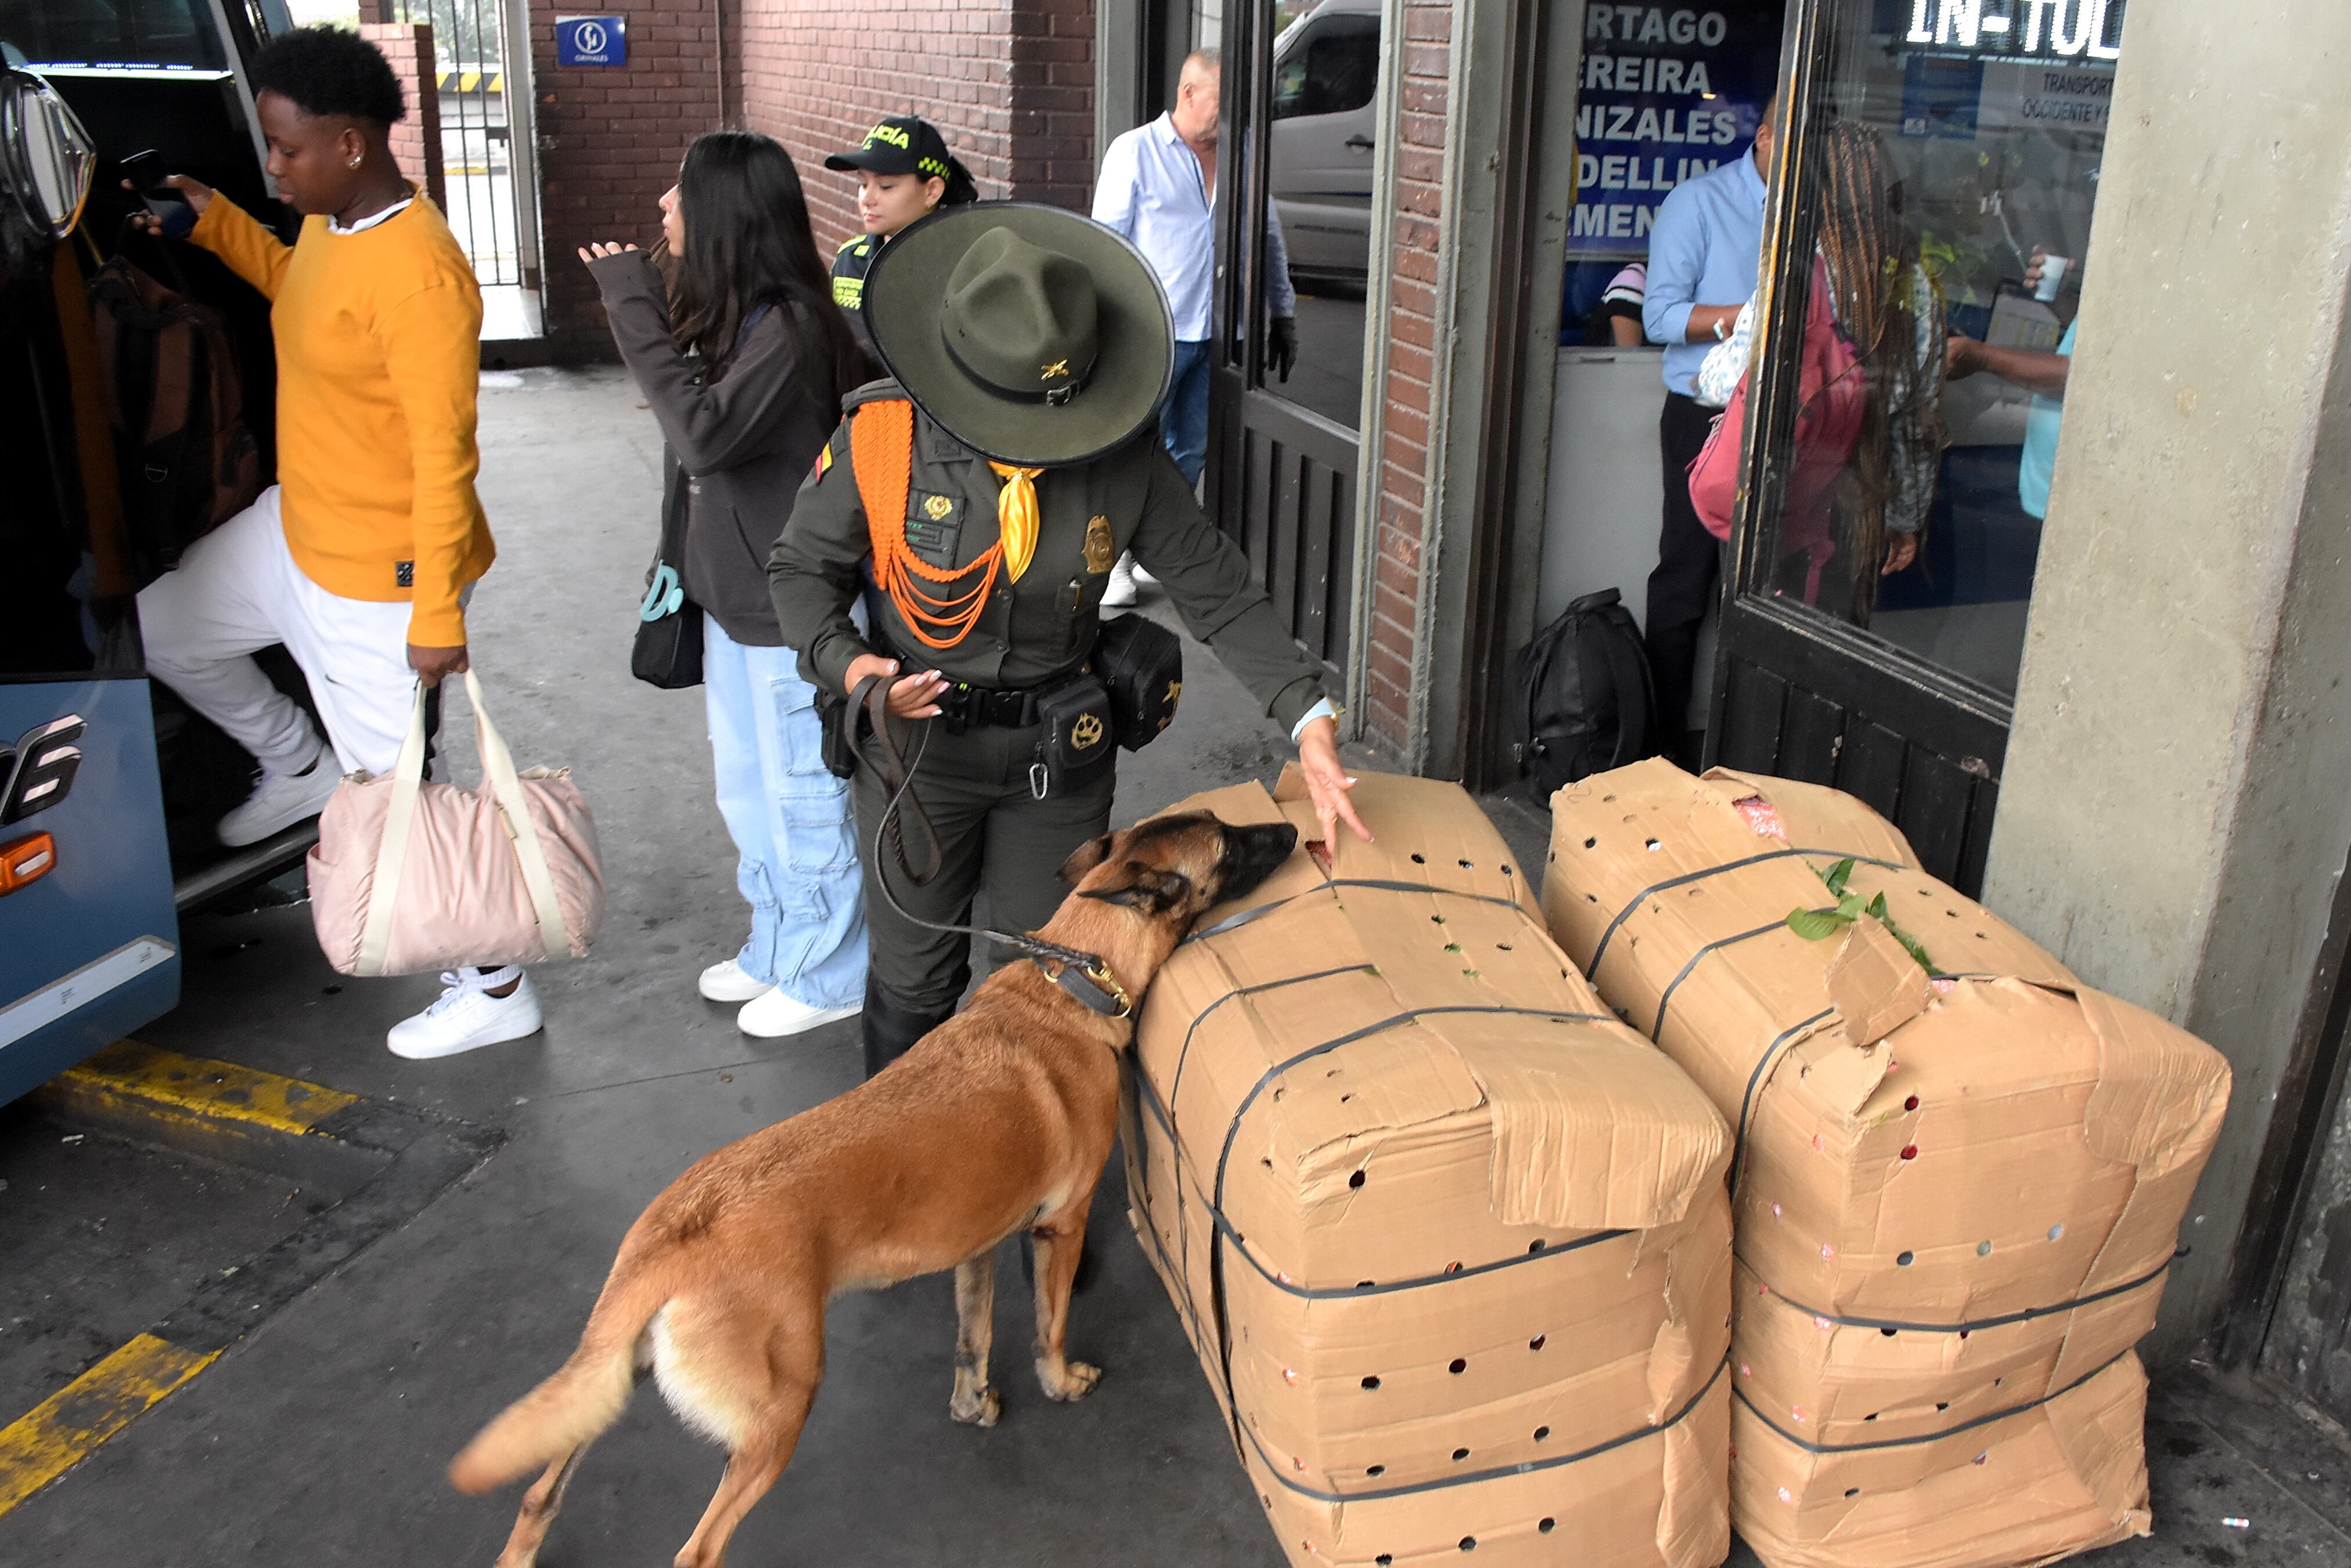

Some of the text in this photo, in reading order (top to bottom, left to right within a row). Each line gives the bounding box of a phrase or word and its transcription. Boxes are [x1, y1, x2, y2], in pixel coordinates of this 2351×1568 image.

[1586, 3, 1727, 46] RTAGO
[1579, 55, 1711, 95] REIRA
[1568, 204, 1662, 237] MEN
